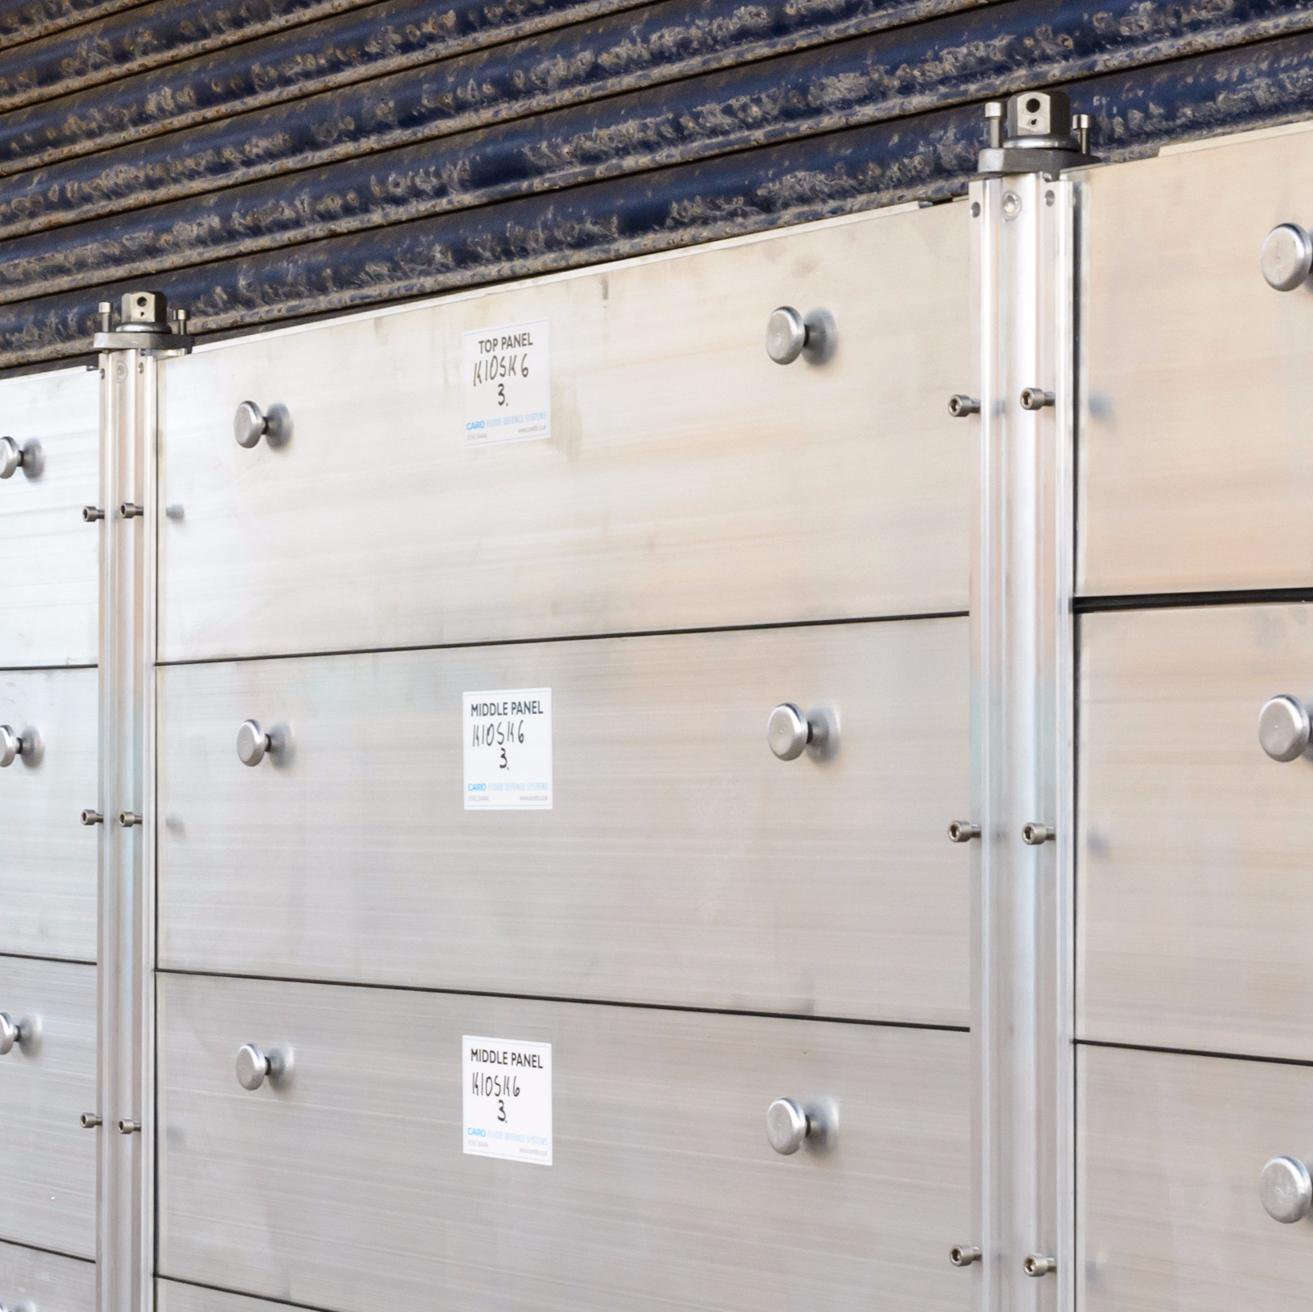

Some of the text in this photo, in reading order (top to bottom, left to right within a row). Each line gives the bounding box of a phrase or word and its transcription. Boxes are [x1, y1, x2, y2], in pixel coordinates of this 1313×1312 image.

[478, 332, 533, 354] TOP PANEL
[471, 700, 543, 716] MIDDLE PANEL
[471, 1048, 543, 1069] MIDDLE PANEL
